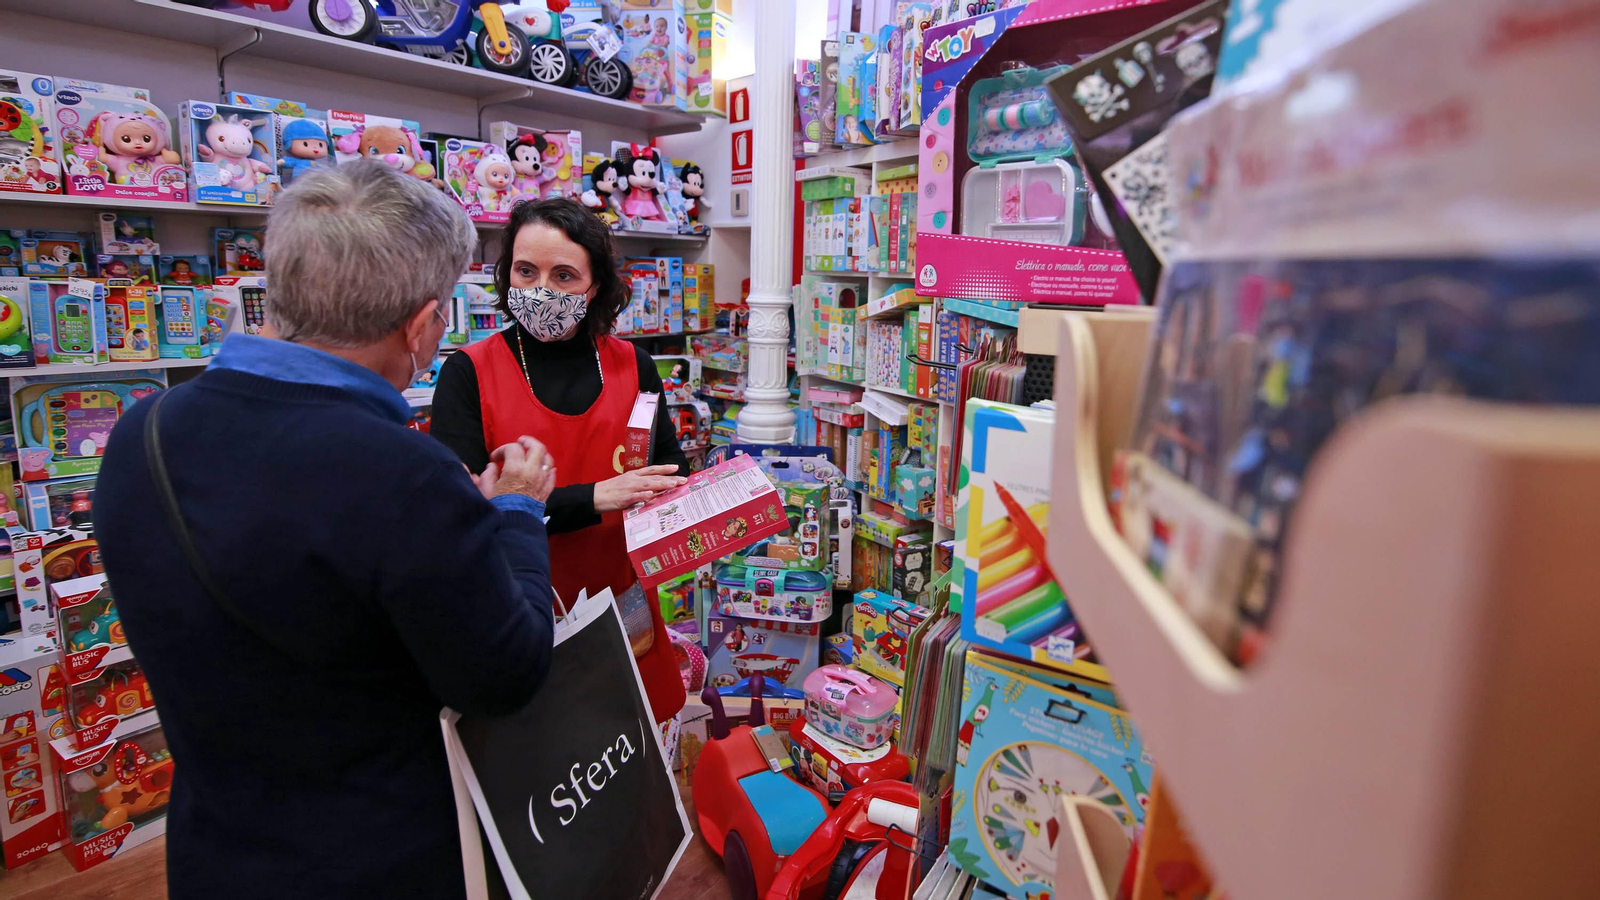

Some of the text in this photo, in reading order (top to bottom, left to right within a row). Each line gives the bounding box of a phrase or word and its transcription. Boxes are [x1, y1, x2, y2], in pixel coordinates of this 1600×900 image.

[58, 94, 80, 102] vtech
[732, 174, 752, 182] EXTINTOR
[75, 182, 105, 191] Love
[1088, 262, 1108, 271] come
[71, 650, 100, 662] MUSIC
[72, 659, 90, 668] BUS
[0, 682, 32, 696] OLTO
[82, 724, 109, 736] MUSIC
[83, 733, 99, 742] BUS
[550, 733, 636, 826] Sfera
[83, 829, 126, 851] MUSICAL
[16, 842, 48, 859] 20460
[84, 840, 116, 858] PIANO
